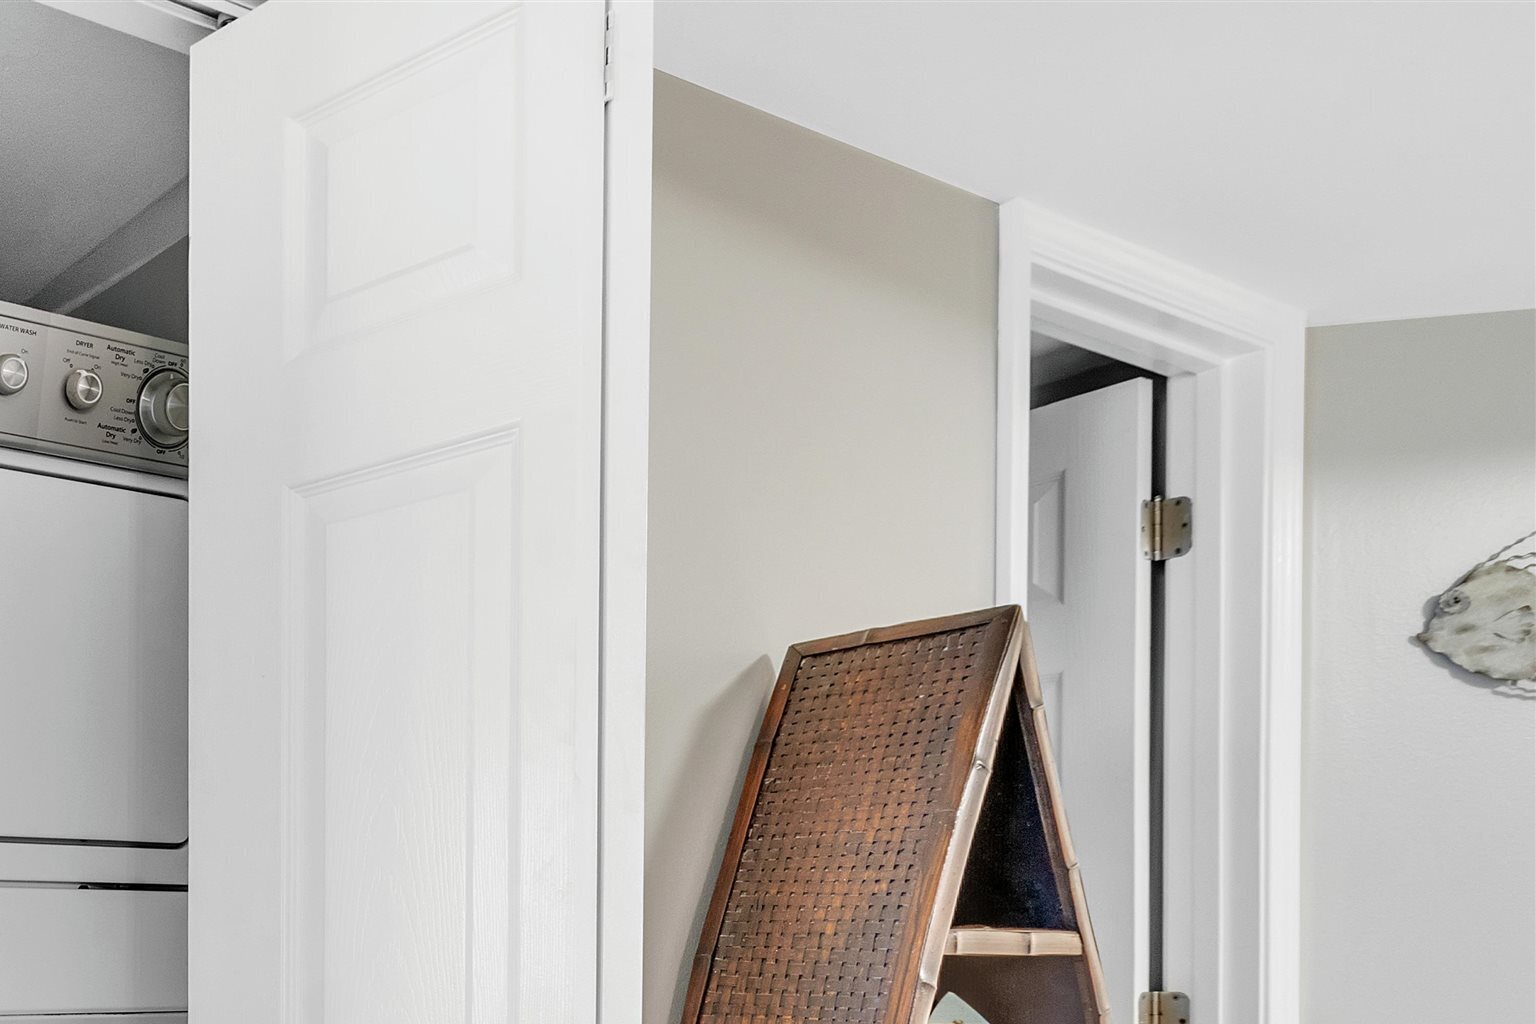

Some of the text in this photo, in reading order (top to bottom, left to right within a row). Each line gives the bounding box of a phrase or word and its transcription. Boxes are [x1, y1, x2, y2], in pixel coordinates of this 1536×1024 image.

[0, 324, 19, 332] WATER
[20, 327, 37, 336] WASH
[76, 340, 94, 348] DRYER
[106, 344, 136, 356] Automatic
[115, 354, 126, 362] Dry
[97, 423, 126, 433] Automatic
[106, 432, 116, 440] Dry
